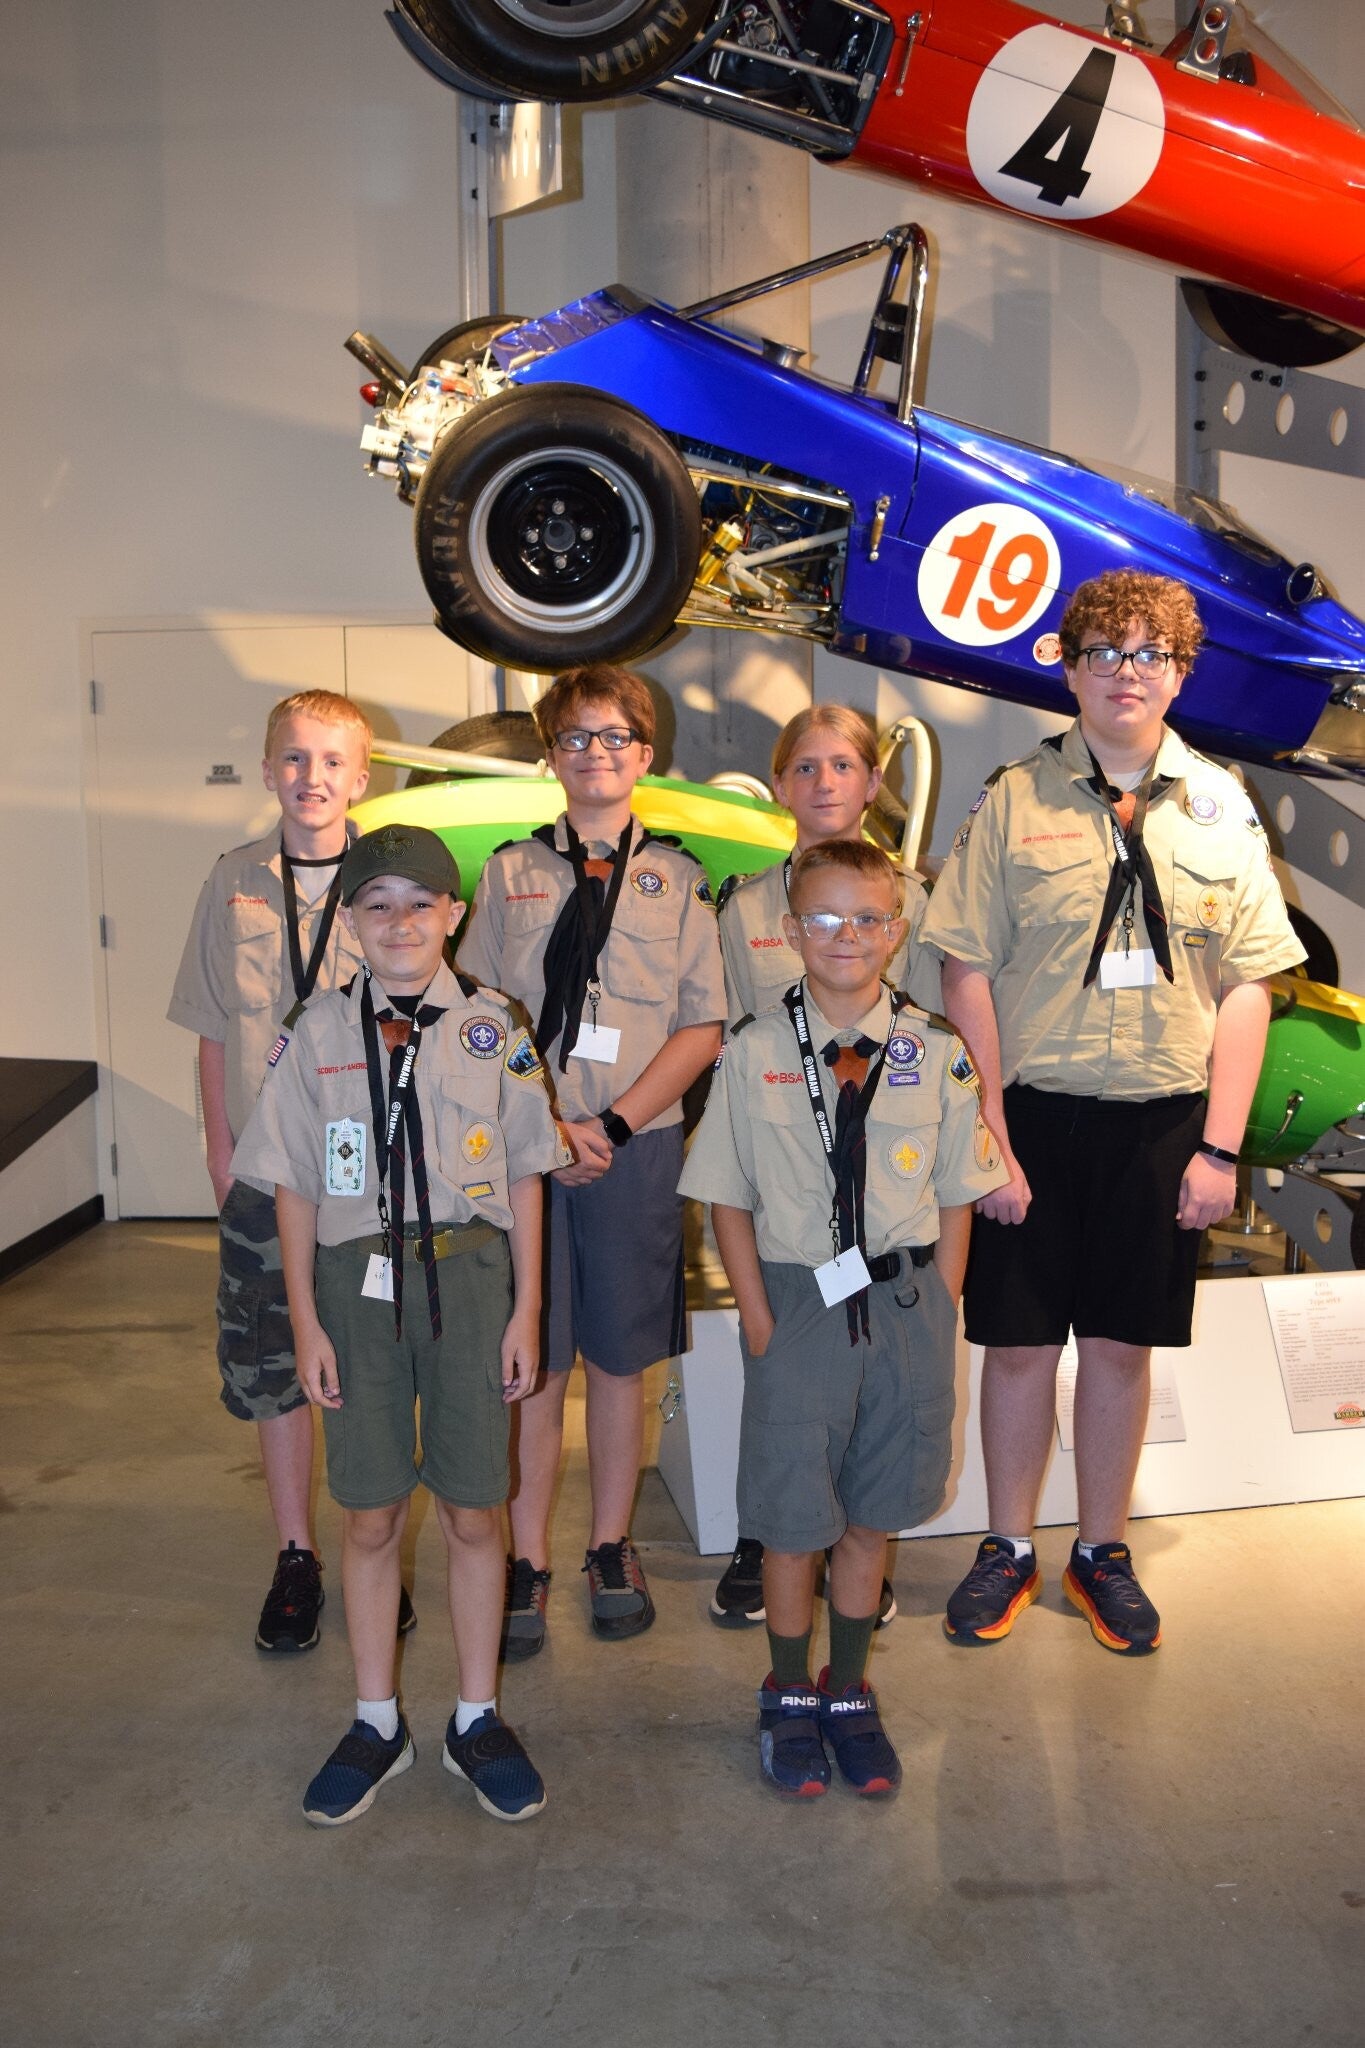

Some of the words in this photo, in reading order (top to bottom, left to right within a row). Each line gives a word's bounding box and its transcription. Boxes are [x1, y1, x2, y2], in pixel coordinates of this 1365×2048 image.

[997, 47, 1116, 206] 4
[941, 521, 1049, 632] 19
[1113, 832, 1128, 861] YAMAHA
[763, 938, 783, 947] BSA
[794, 1012, 809, 1044] YAMAHA
[397, 1055, 413, 1088] YAMAHA
[779, 1073, 804, 1083] BSA
[805, 1065, 820, 1098] YAMAHA
[386, 1112, 400, 1146] YAMAHA
[817, 1120, 833, 1153] YAMAHA
